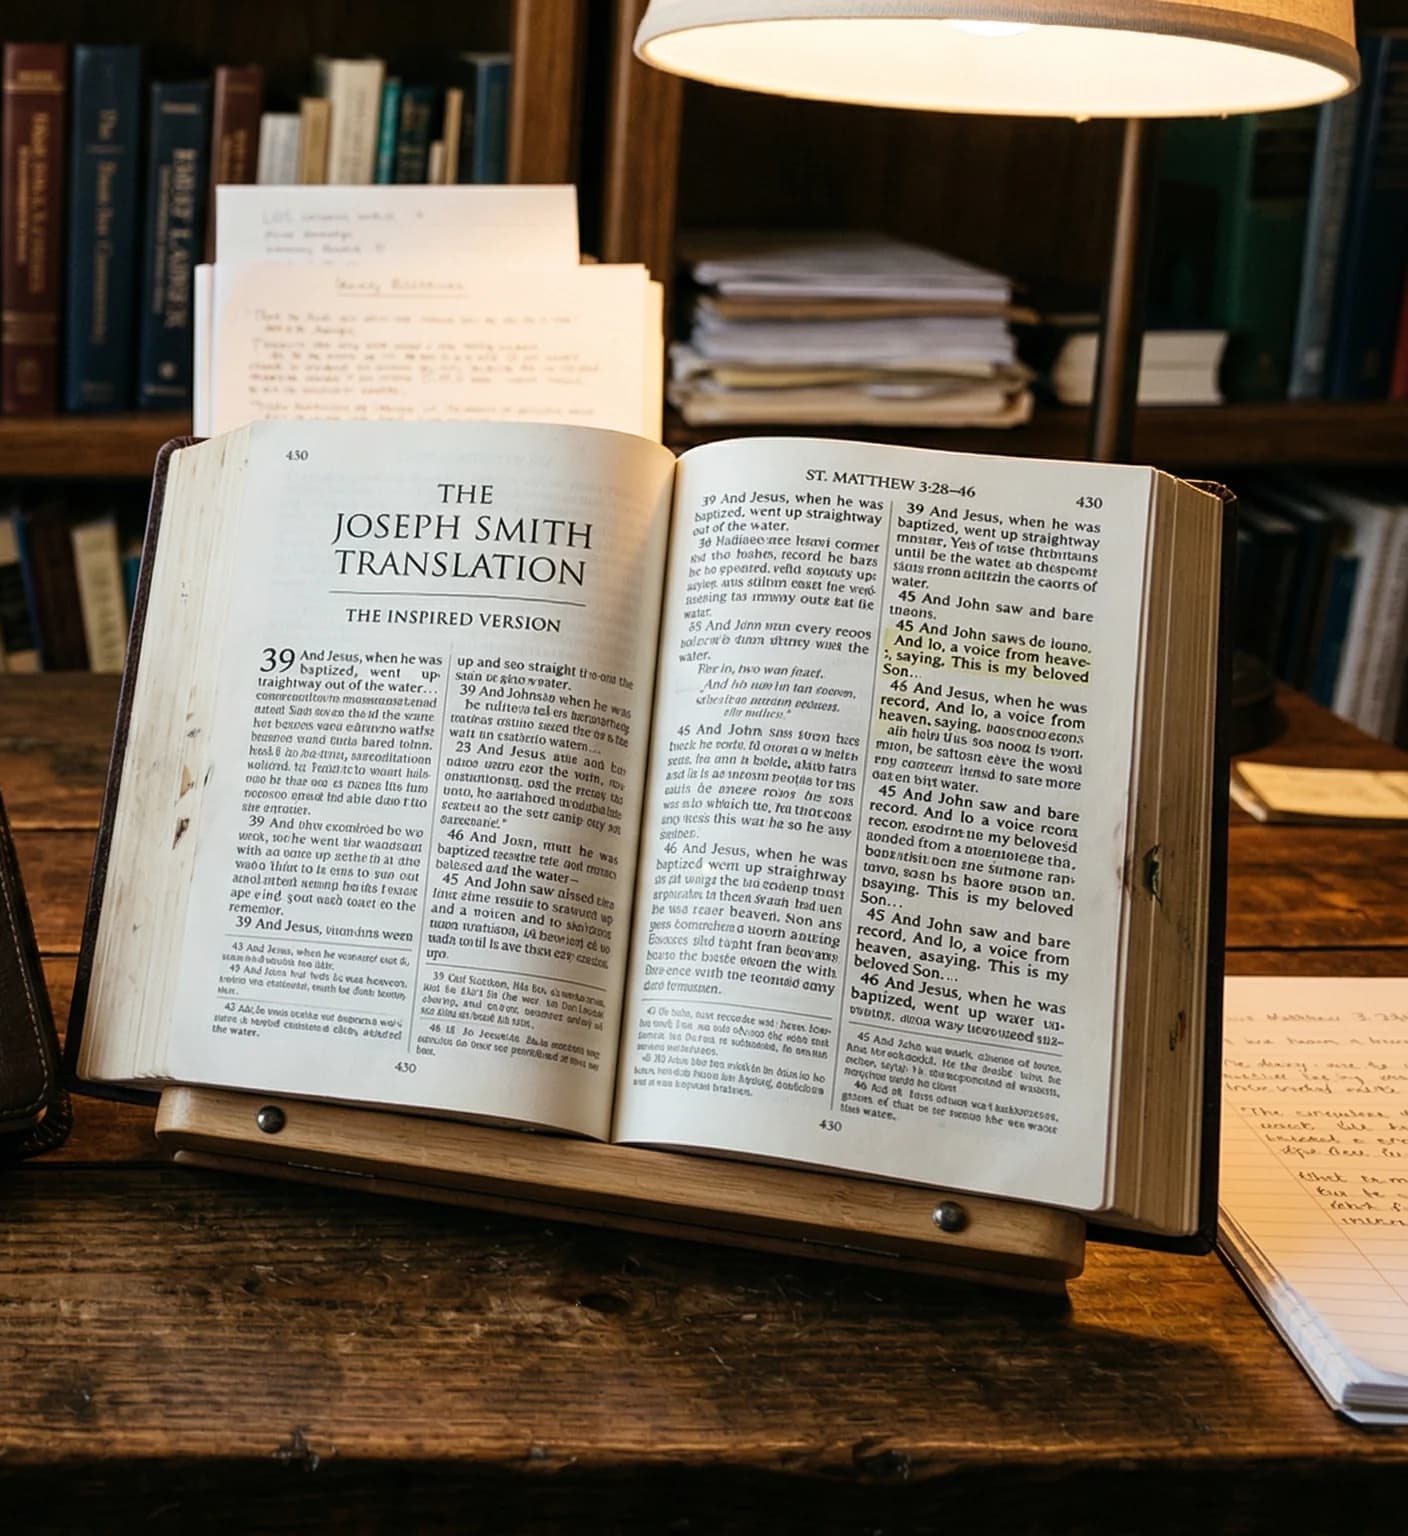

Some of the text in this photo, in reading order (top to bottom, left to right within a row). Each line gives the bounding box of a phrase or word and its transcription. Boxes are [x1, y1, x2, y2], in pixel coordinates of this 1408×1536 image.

[806, 470, 827, 481] ST.
[833, 472, 915, 490] MATTHEW
[438, 484, 493, 504] THE
[721, 492, 746, 504] And
[750, 492, 789, 504] Jesus,
[796, 493, 830, 505] when
[837, 495, 853, 507] he
[859, 500, 883, 510] was
[1076, 497, 1102, 508] 430
[750, 508, 882, 527] went up straightway
[332, 513, 592, 549] JOSEPH SMITH
[336, 550, 586, 586] TRANSLATION
[899, 591, 1093, 622] 45 And John saw and bare
[346, 609, 560, 632] THE INSPIRED VERSION
[260, 648, 442, 672] 39 And Jesus, when he was
[894, 635, 1091, 667] And lo, a voice from heave-
[300, 664, 400, 678] baptized, went
[952, 656, 981, 670] This
[988, 660, 999, 672] is
[1006, 666, 1026, 678] my
[1033, 665, 1089, 682] beloved
[325, 681, 344, 689] out
[349, 680, 362, 690] of
[365, 680, 384, 691] the
[696, 723, 722, 734] And
[728, 724, 762, 736] John
[443, 873, 555, 896] 45 And John saw
[913, 932, 942, 947] And
[949, 936, 966, 952] lo,
[973, 944, 981, 952] a
[989, 945, 1027, 960] voice
[1035, 949, 1069, 966] from
[988, 959, 1020, 975] This
[1027, 964, 1038, 977] is
[1046, 971, 1069, 985] my
[230, 1028, 259, 1036] water.
[395, 1062, 416, 1073] 430
[819, 1120, 842, 1131] 430
